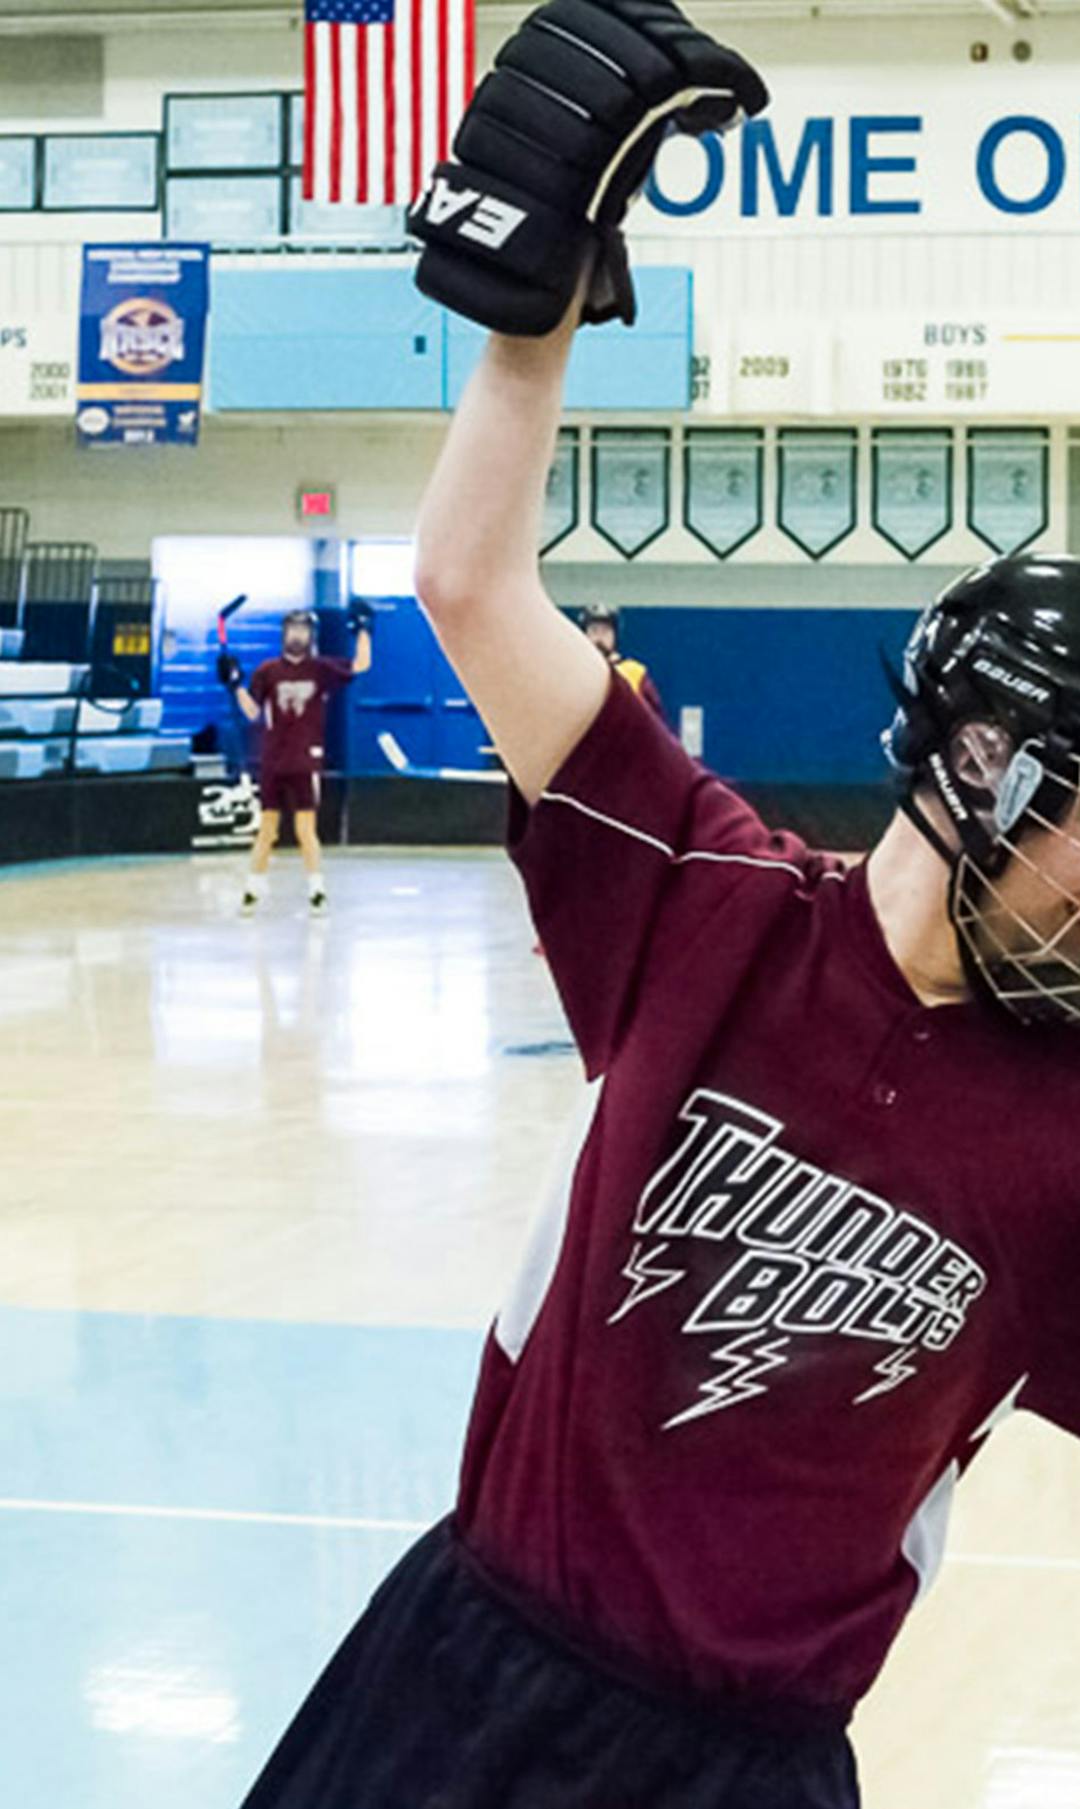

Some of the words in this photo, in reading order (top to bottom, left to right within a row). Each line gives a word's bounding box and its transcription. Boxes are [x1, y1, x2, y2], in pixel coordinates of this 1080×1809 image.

[643, 113, 922, 217] OME
[408, 177, 529, 250] EA
[923, 323, 987, 346] BOYS
[972, 658, 1050, 704] BAUER
[632, 1088, 988, 1311] THUNDER
[681, 1248, 967, 1351] BOLTS
